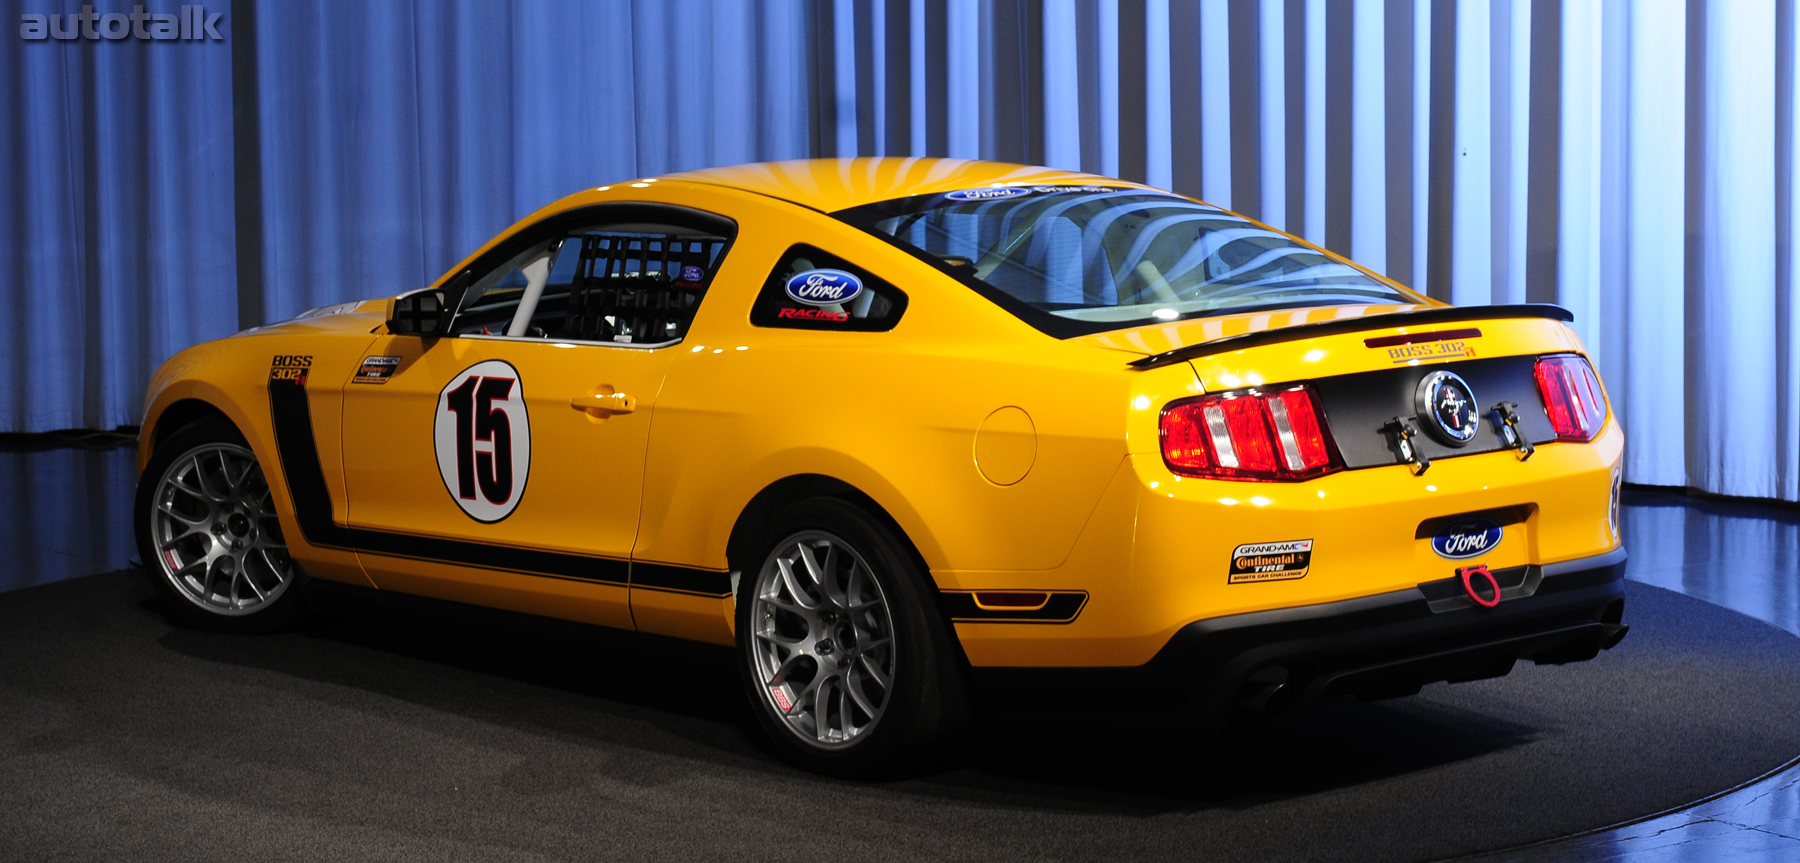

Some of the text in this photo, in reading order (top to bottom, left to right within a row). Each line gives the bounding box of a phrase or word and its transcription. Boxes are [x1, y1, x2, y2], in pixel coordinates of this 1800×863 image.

[964, 190, 1016, 199] Ford
[799, 273, 848, 300] Ford
[778, 307, 851, 322] RACING
[1388, 343, 1434, 359] BOSS
[272, 355, 313, 367] BOSS
[447, 375, 516, 506] 15
[1445, 523, 1488, 555] Ford
[1240, 543, 1295, 554] GRAND-AM
[1236, 553, 1295, 570] Continental
[1254, 563, 1286, 573] TIRE
